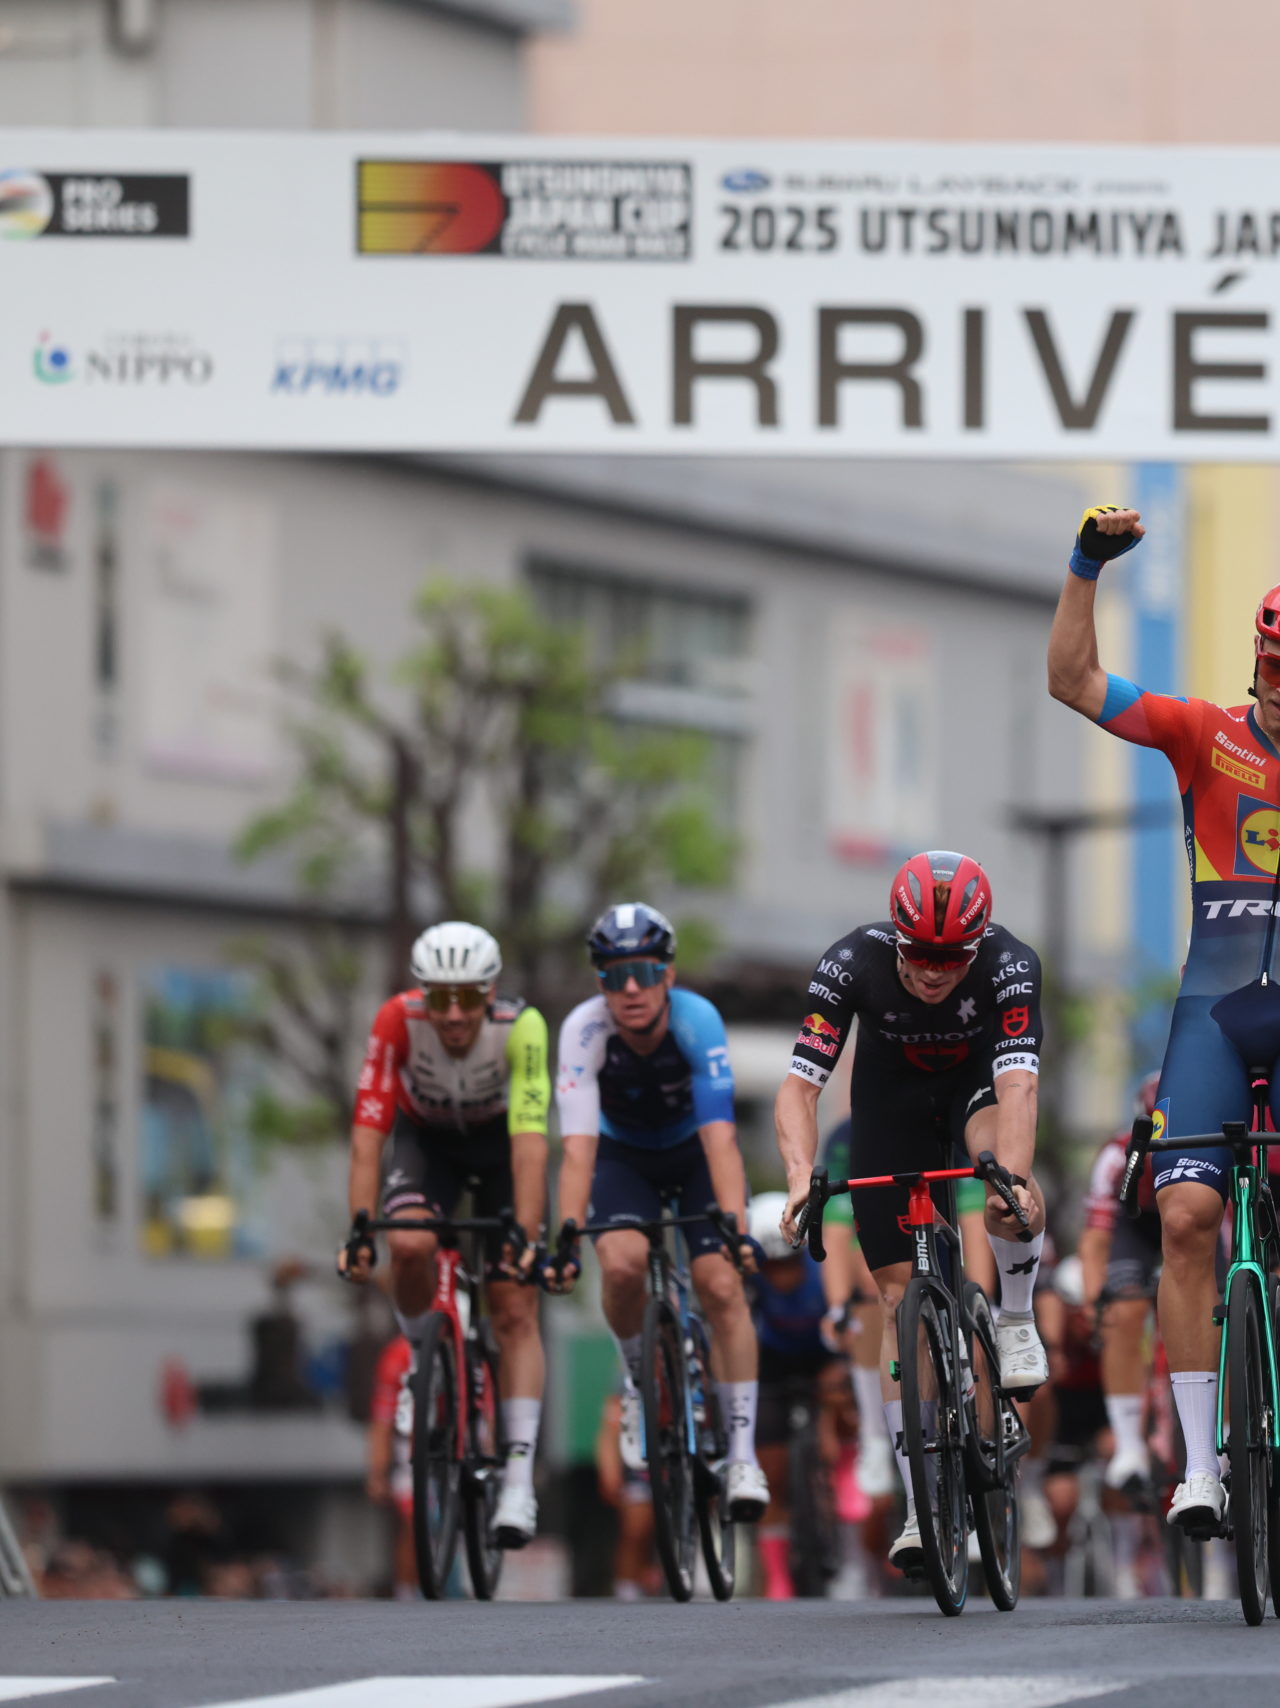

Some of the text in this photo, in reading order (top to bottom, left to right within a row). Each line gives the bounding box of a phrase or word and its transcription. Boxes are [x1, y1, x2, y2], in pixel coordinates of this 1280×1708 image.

[718, 203, 839, 254] 2025
[859, 206, 1184, 256] UTSUNOMIYA
[86, 351, 213, 384] NIPPO
[271, 360, 400, 395] KPMG
[1214, 730, 1267, 768] Santini
[1216, 753, 1261, 785] PIRELLI
[899, 892, 916, 917] TUDOR
[966, 897, 983, 920] TUDOR
[866, 928, 896, 946] BMC
[816, 958, 854, 987] MSC
[992, 960, 1030, 987] MSC
[808, 980, 842, 1006] BMC
[996, 981, 1033, 1004] BMC
[994, 1036, 1036, 1051] TUDOR
[792, 1060, 815, 1077] BOSS
[996, 1056, 1026, 1069] BOSS
[1176, 1157, 1223, 1176] Santini
[916, 1231, 930, 1271] BMC
